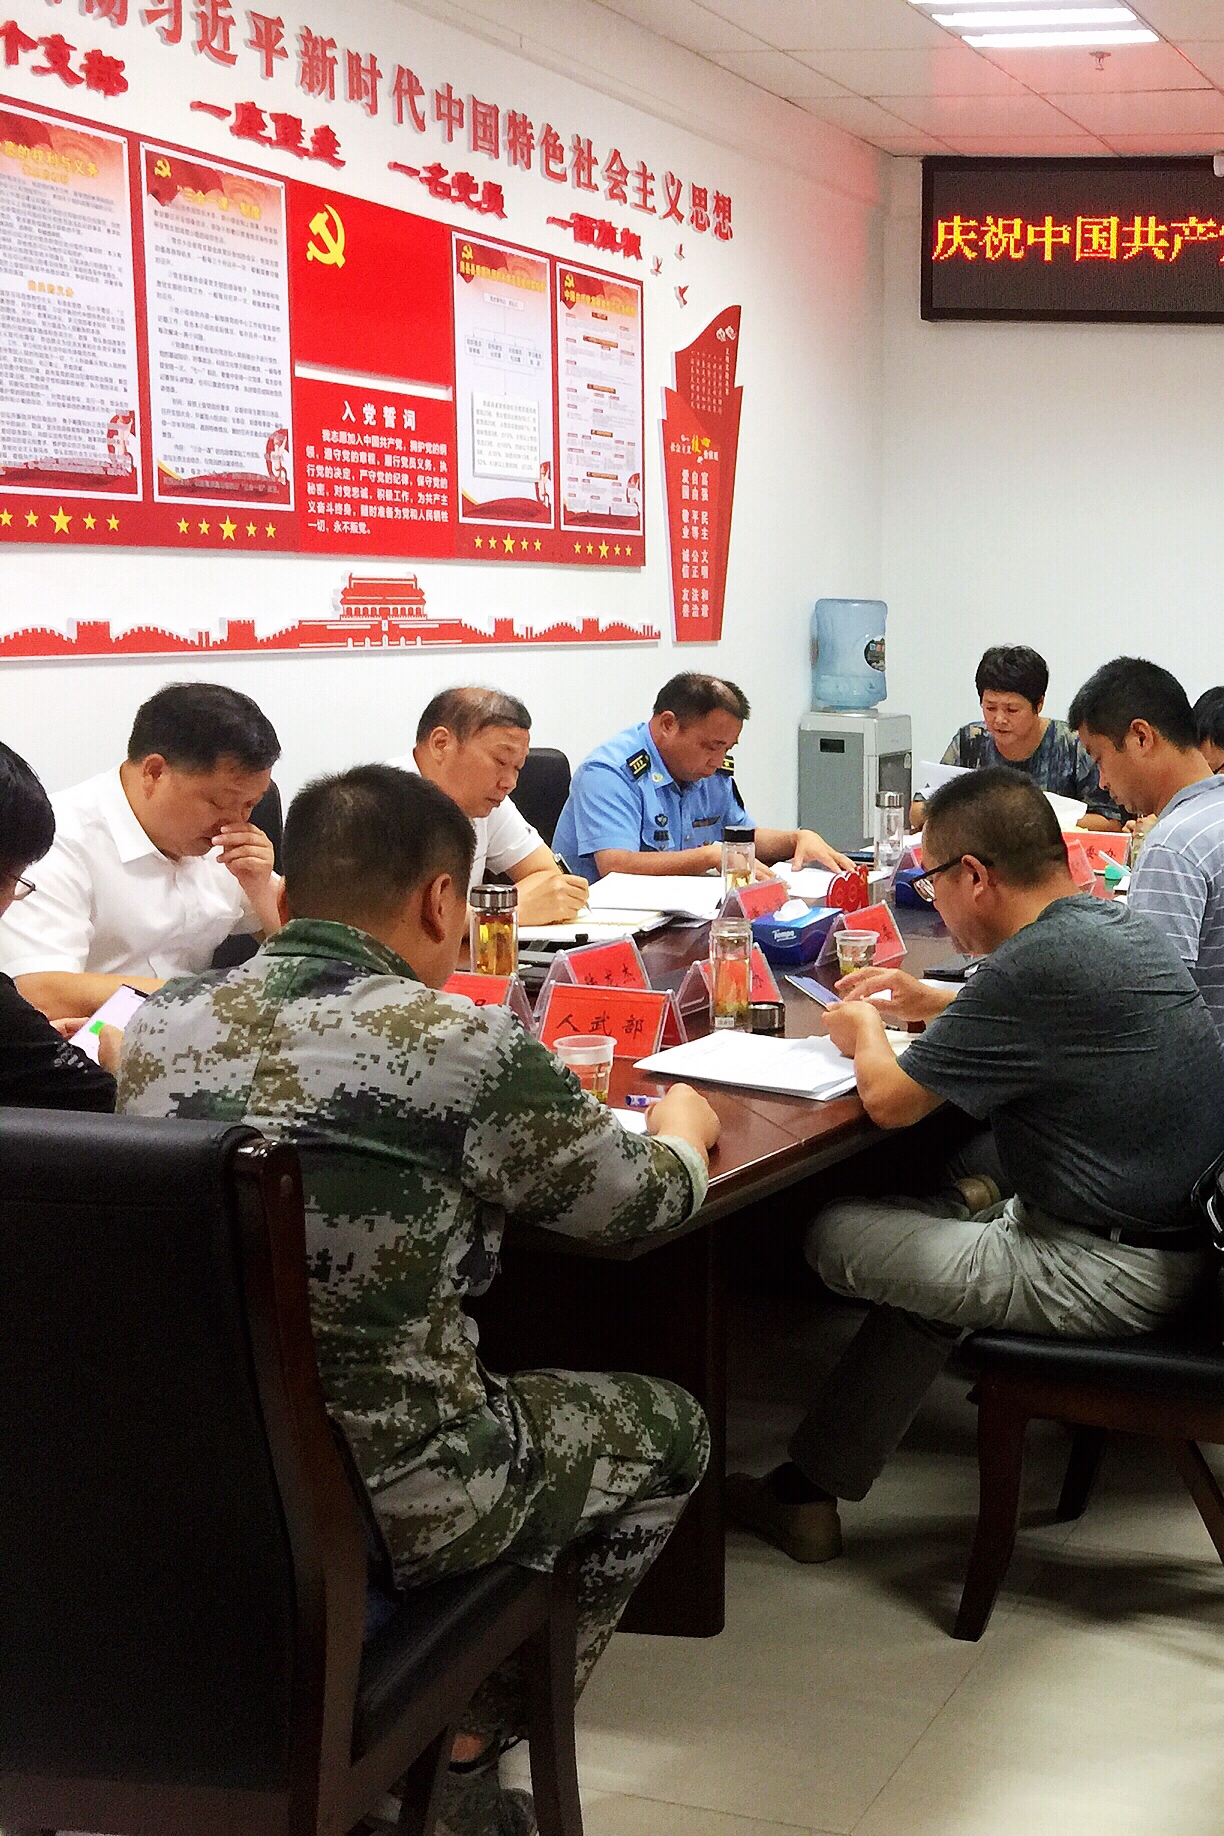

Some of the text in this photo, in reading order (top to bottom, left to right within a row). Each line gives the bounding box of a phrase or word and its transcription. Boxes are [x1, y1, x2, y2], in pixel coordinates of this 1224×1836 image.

[341, 400, 417, 431] 入党誓词
[556, 1011, 645, 1039] 人武部
